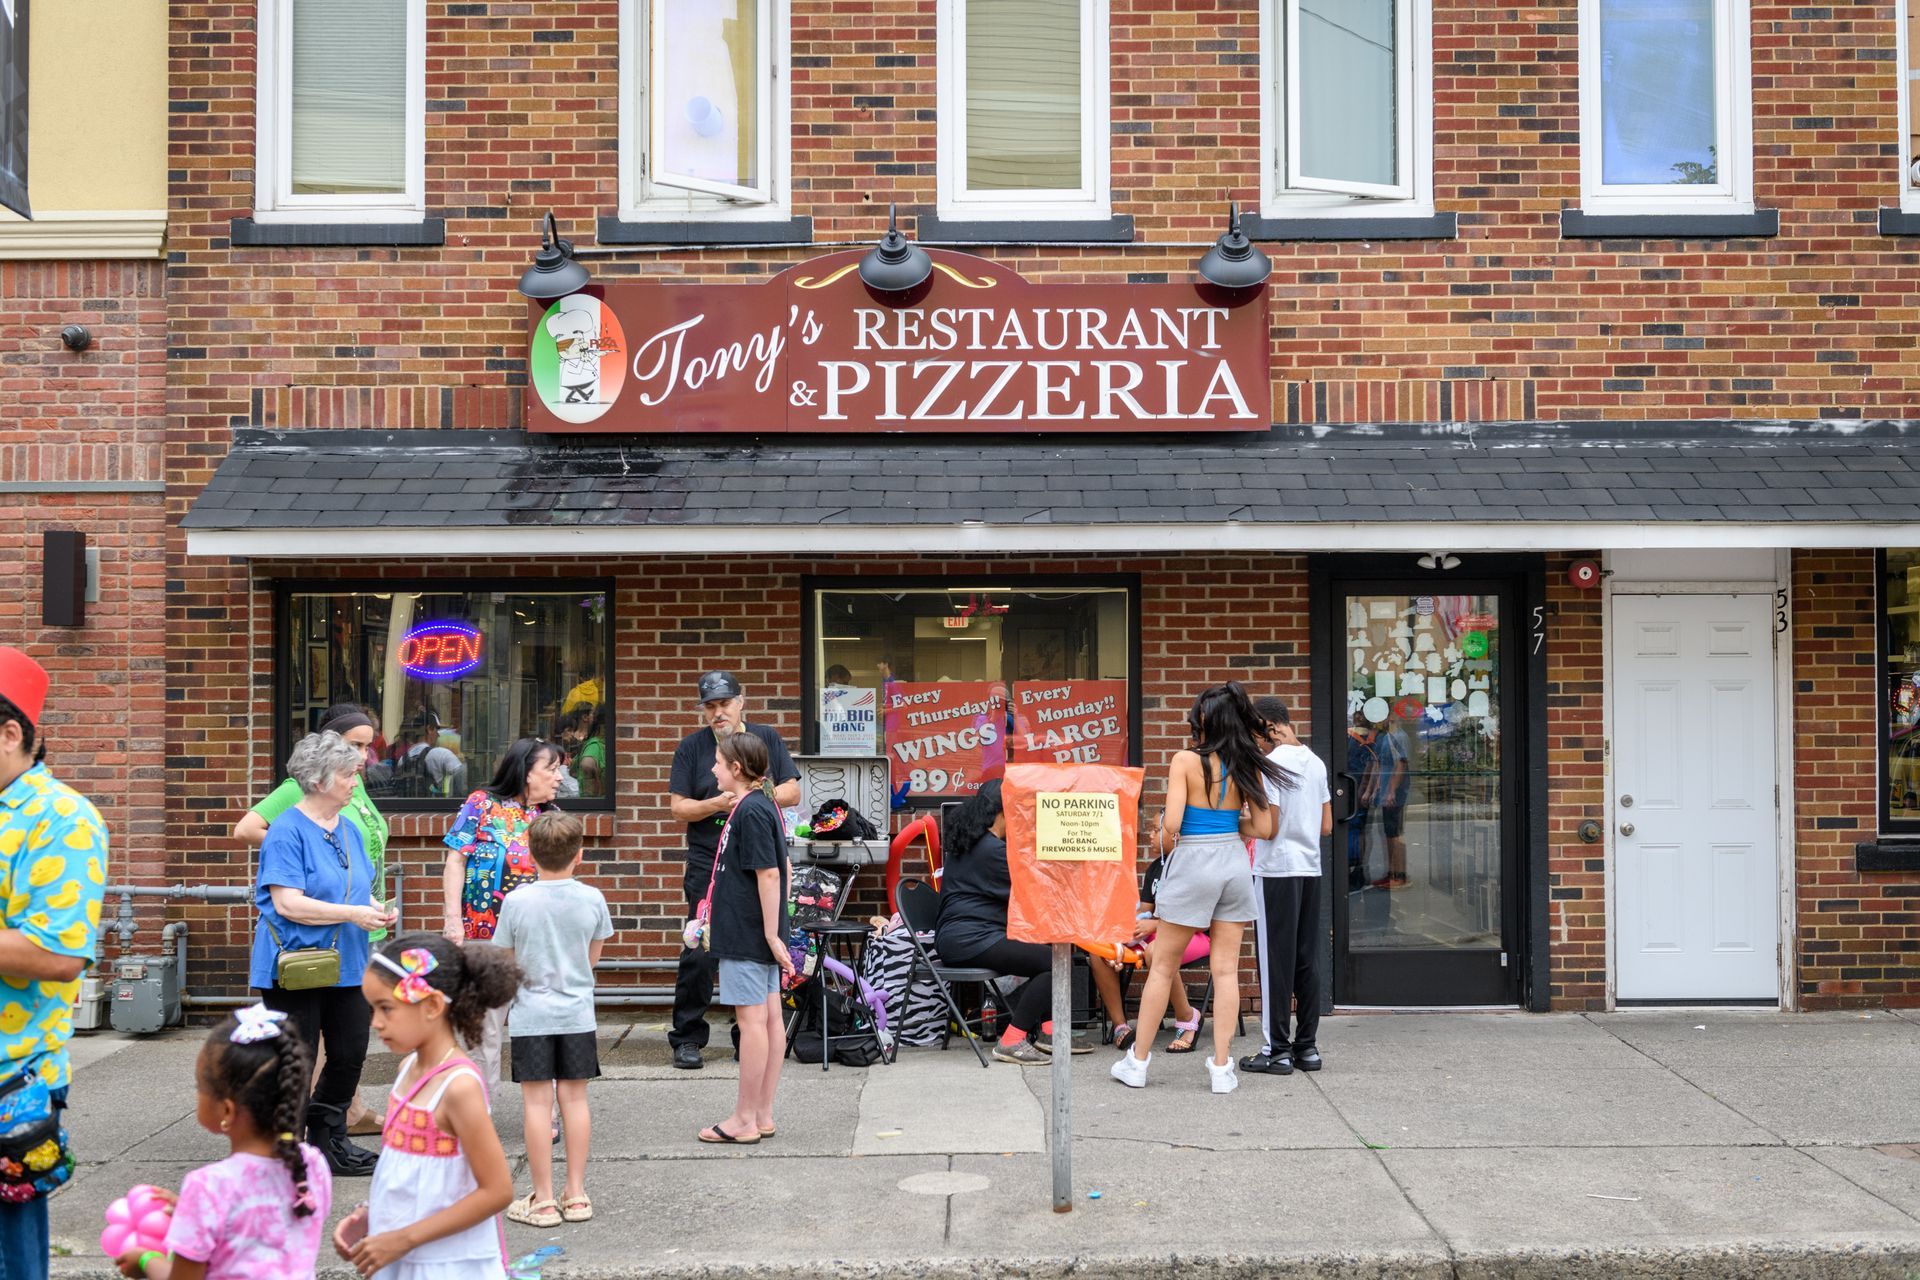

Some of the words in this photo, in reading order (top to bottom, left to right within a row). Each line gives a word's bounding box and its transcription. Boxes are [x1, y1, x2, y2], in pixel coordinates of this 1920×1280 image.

[633, 304, 823, 407] Tony's
[853, 307, 1230, 351] RESTAURANT
[790, 380, 818, 407] &
[818, 359, 1259, 421] PIZZERIA
[947, 615, 965, 627] EXIT
[397, 632, 483, 667] OPEN
[891, 689, 942, 709] Every
[1020, 685, 1072, 705] Every
[847, 710, 874, 722] BIG
[907, 695, 1001, 727] Thursday!!
[1036, 695, 1116, 724] Monday!!
[832, 722, 865, 732] BANG
[1024, 716, 1120, 752] LARGE
[893, 723, 998, 763] WINGS
[1053, 743, 1101, 764] PIE
[1042, 799, 1060, 809] NO
[1064, 799, 1115, 809] PARKING
